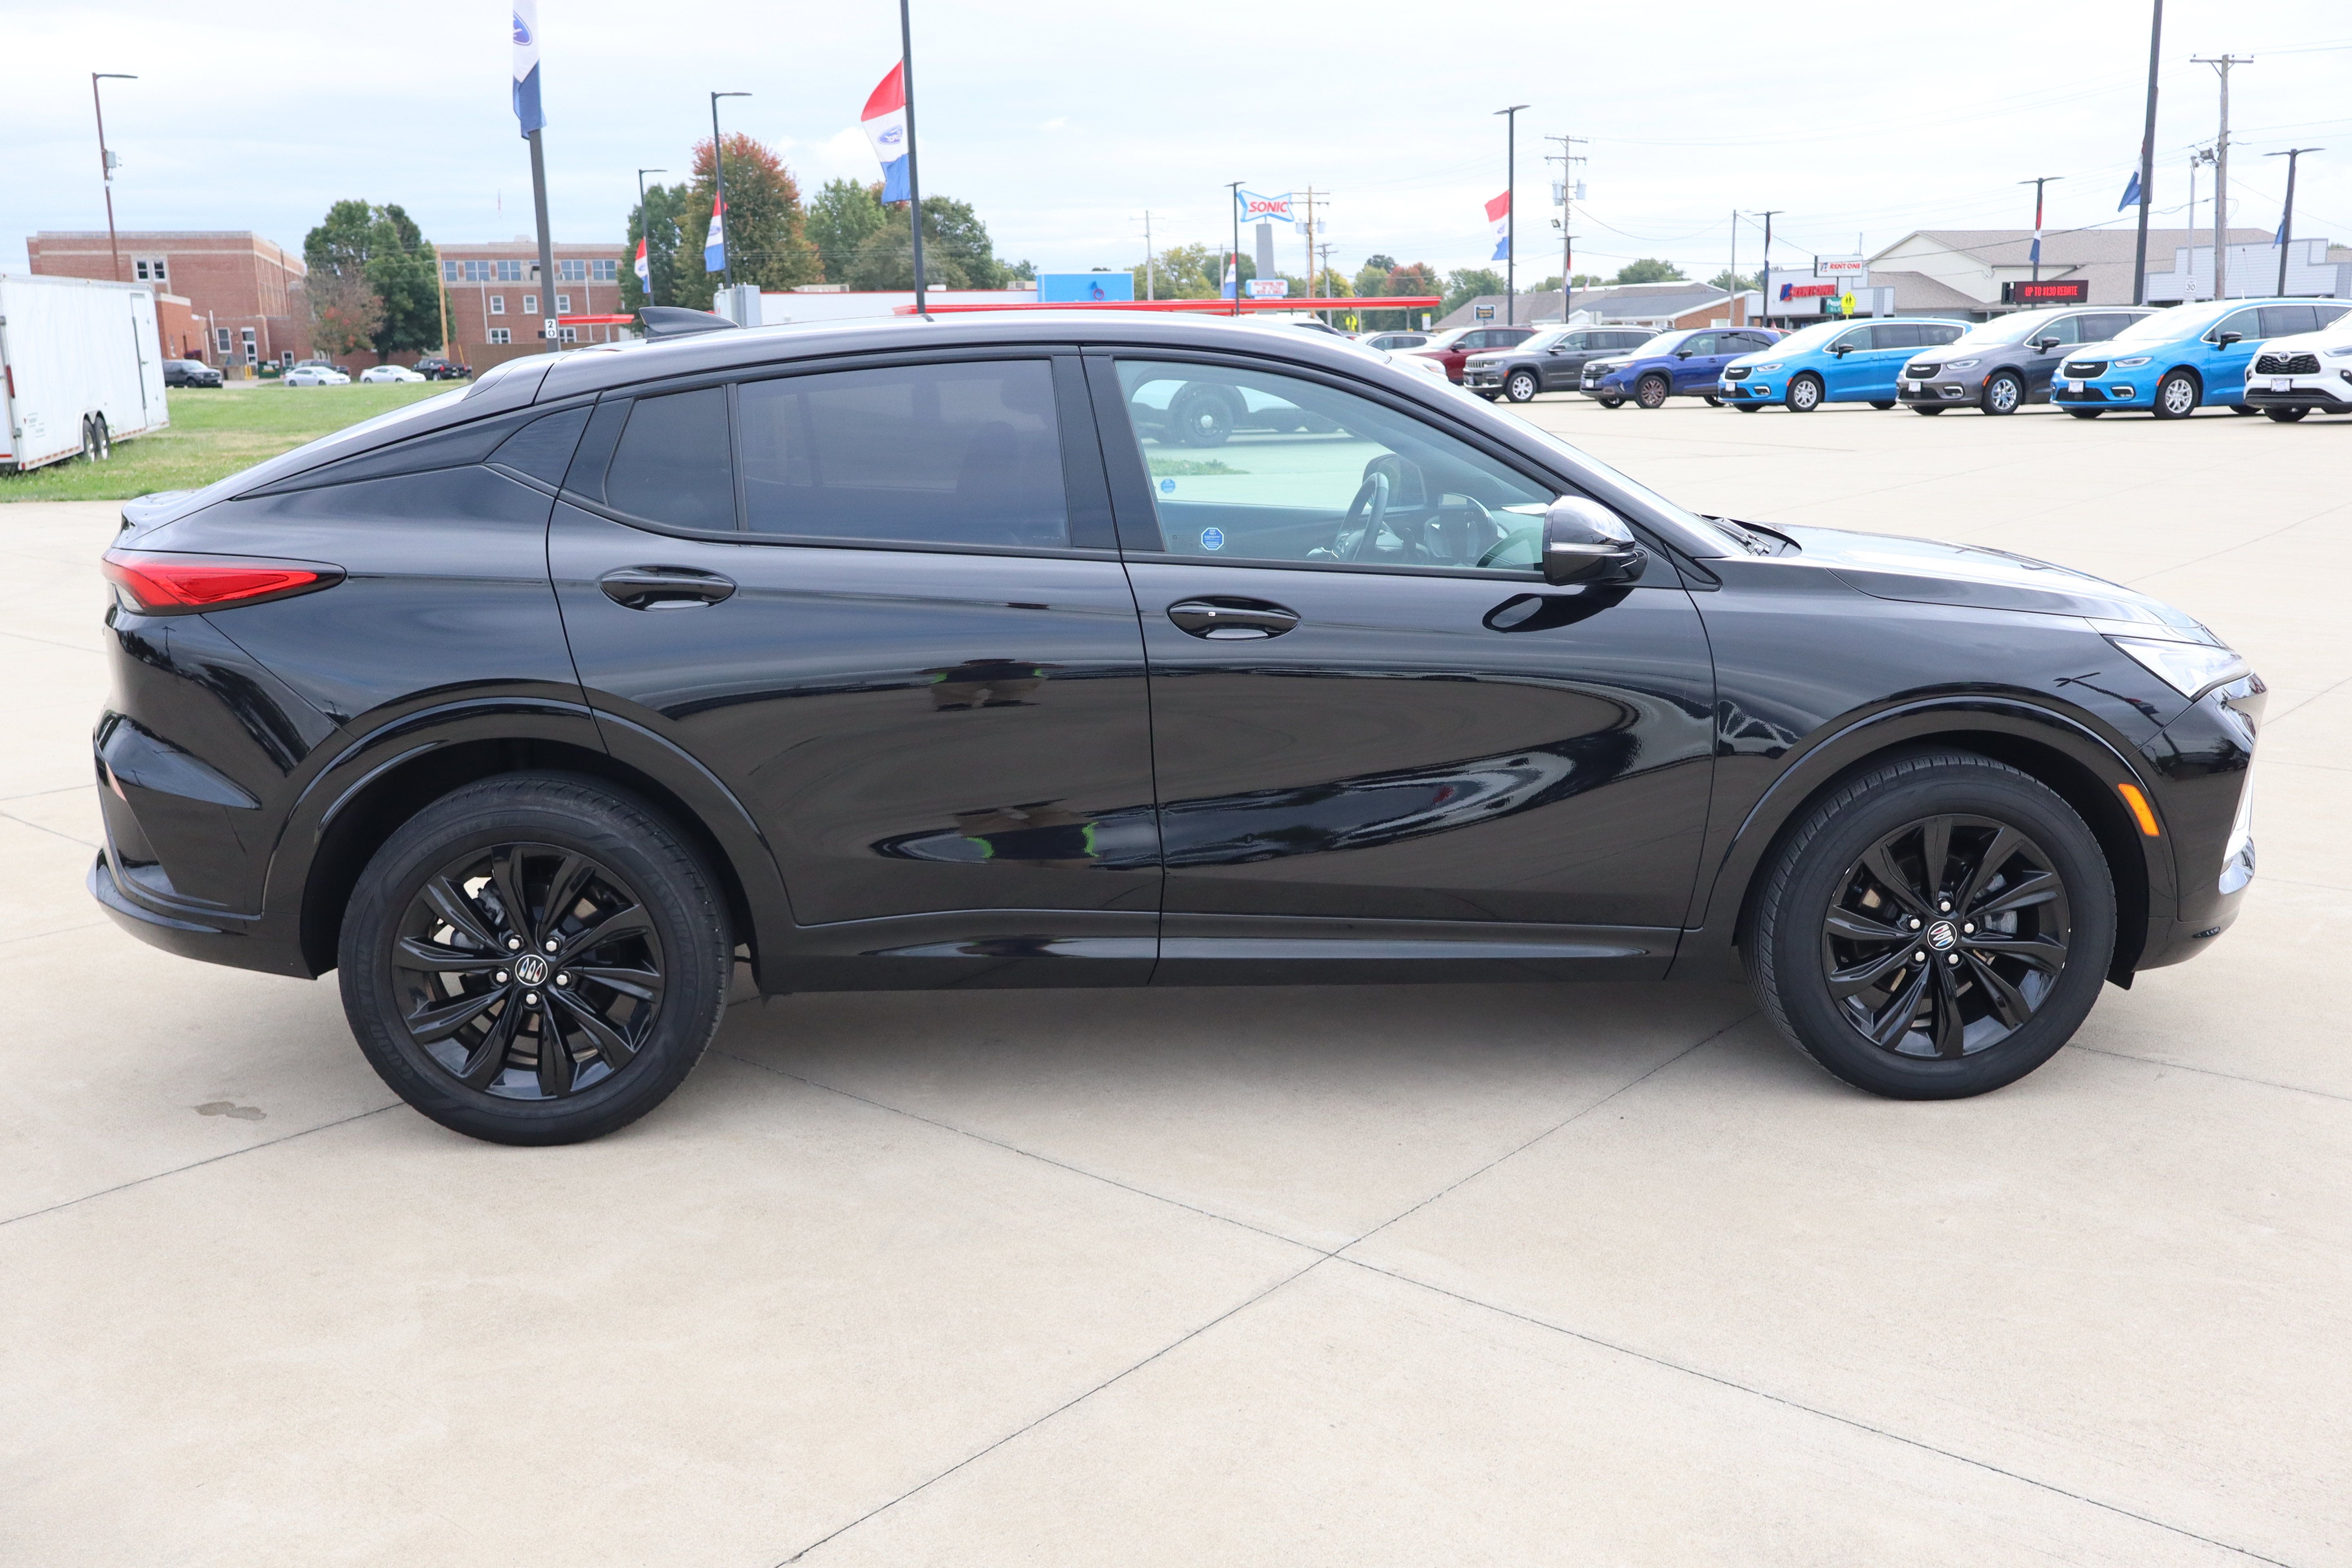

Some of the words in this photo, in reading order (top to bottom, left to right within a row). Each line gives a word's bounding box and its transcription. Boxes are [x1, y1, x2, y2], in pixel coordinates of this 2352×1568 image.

[1249, 202, 1288, 212] SONIC
[1791, 286, 1816, 297] RENT
[1816, 285, 1835, 296] ONE
[2025, 286, 2033, 296] UP
[2034, 286, 2042, 296] TO
[2043, 286, 2056, 296] $130
[2057, 285, 2078, 296] REBATE
